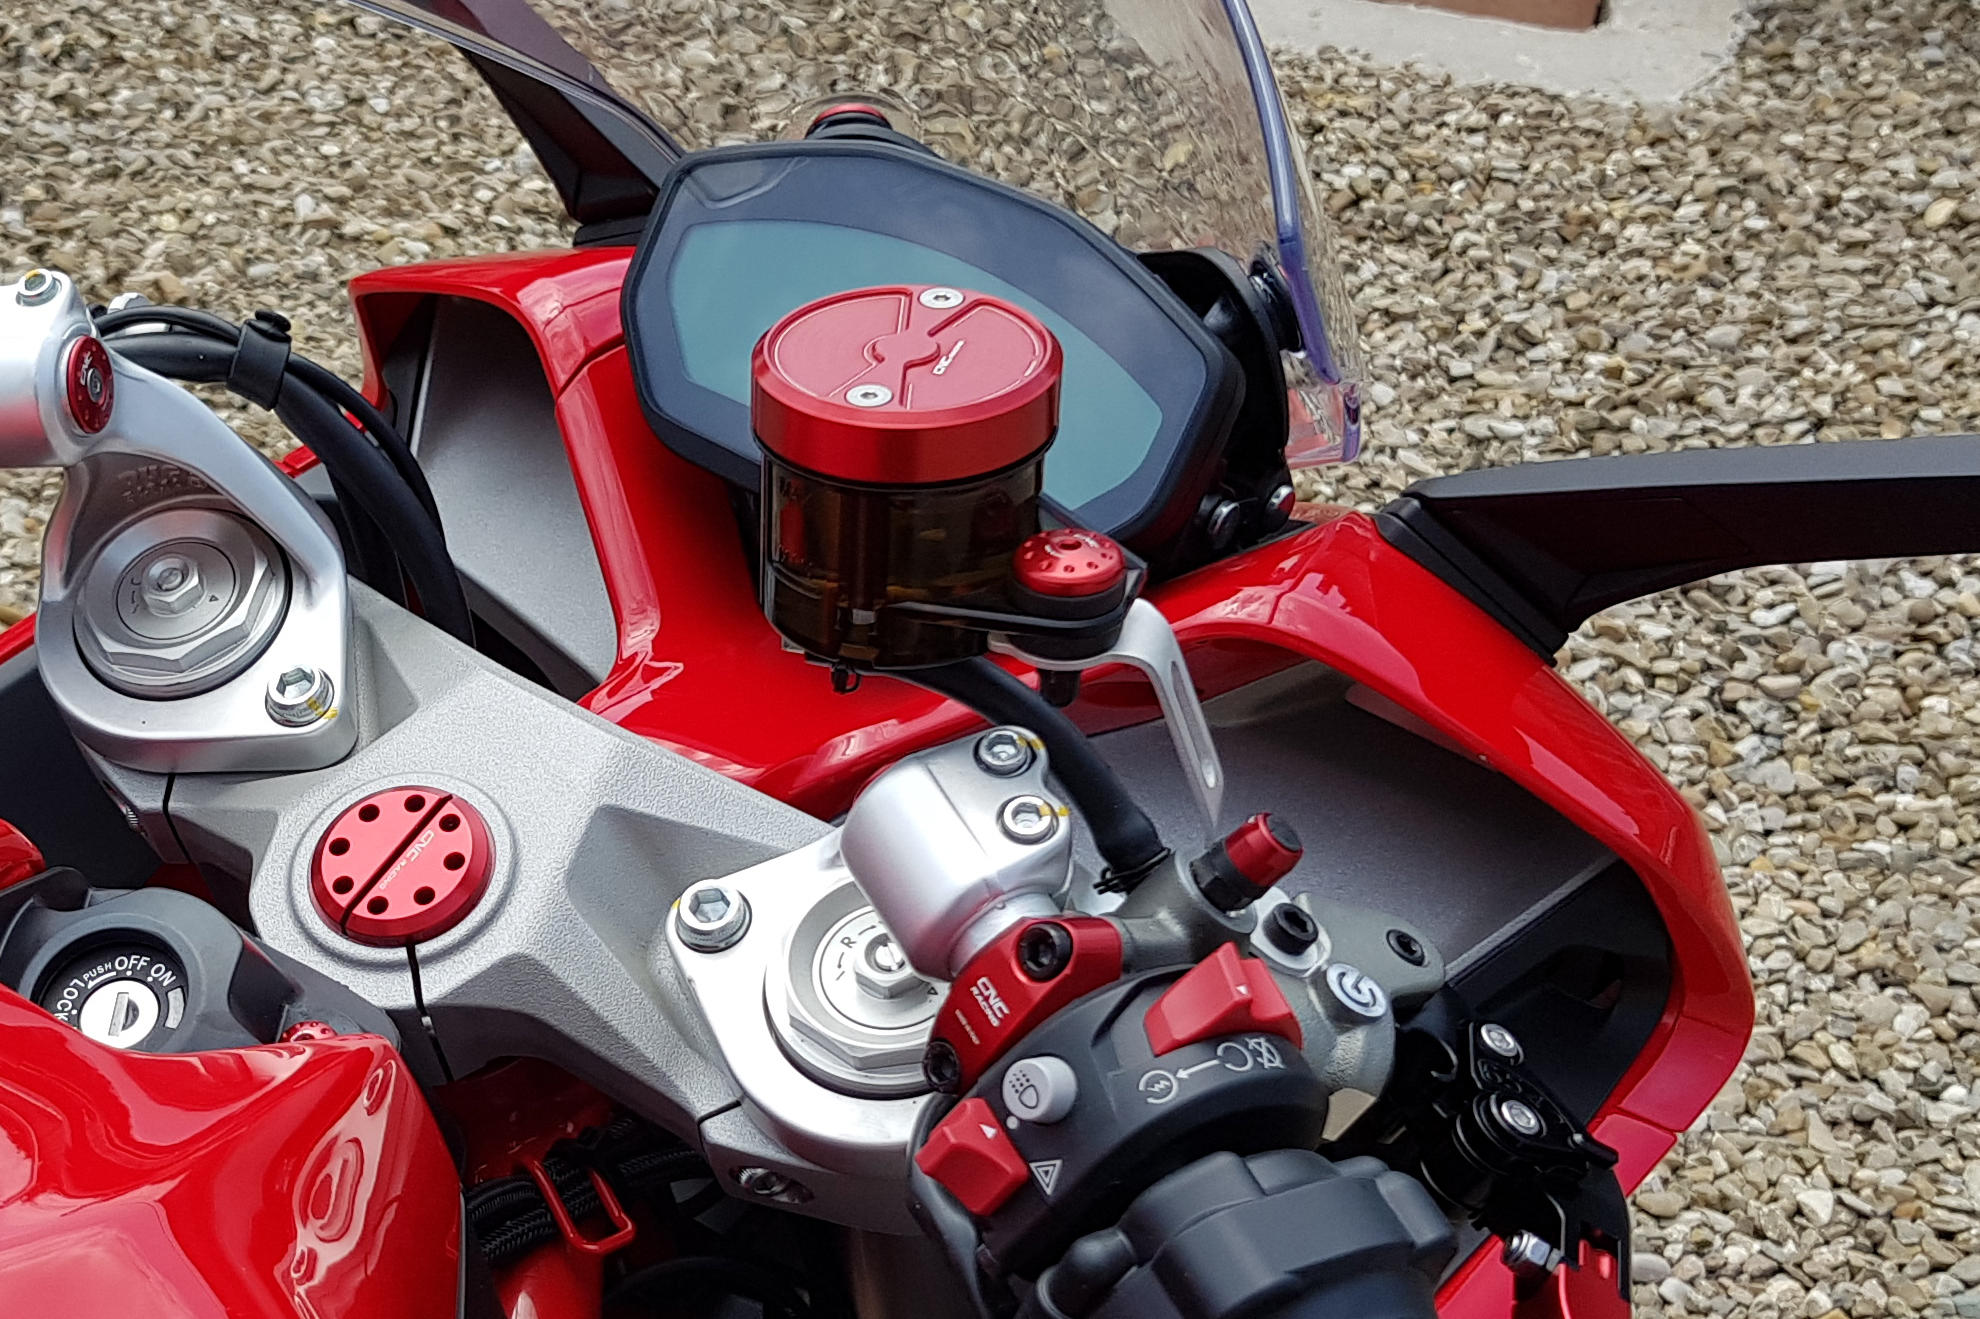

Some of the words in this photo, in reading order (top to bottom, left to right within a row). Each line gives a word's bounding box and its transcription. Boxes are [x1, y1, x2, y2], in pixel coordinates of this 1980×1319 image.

[405, 829, 436, 862] CNC
[840, 936, 857, 949] R
[82, 961, 112, 981] PUSH
[114, 954, 151, 971] OFF
[150, 963, 177, 987] ON
[976, 976, 1010, 1019] CNC
